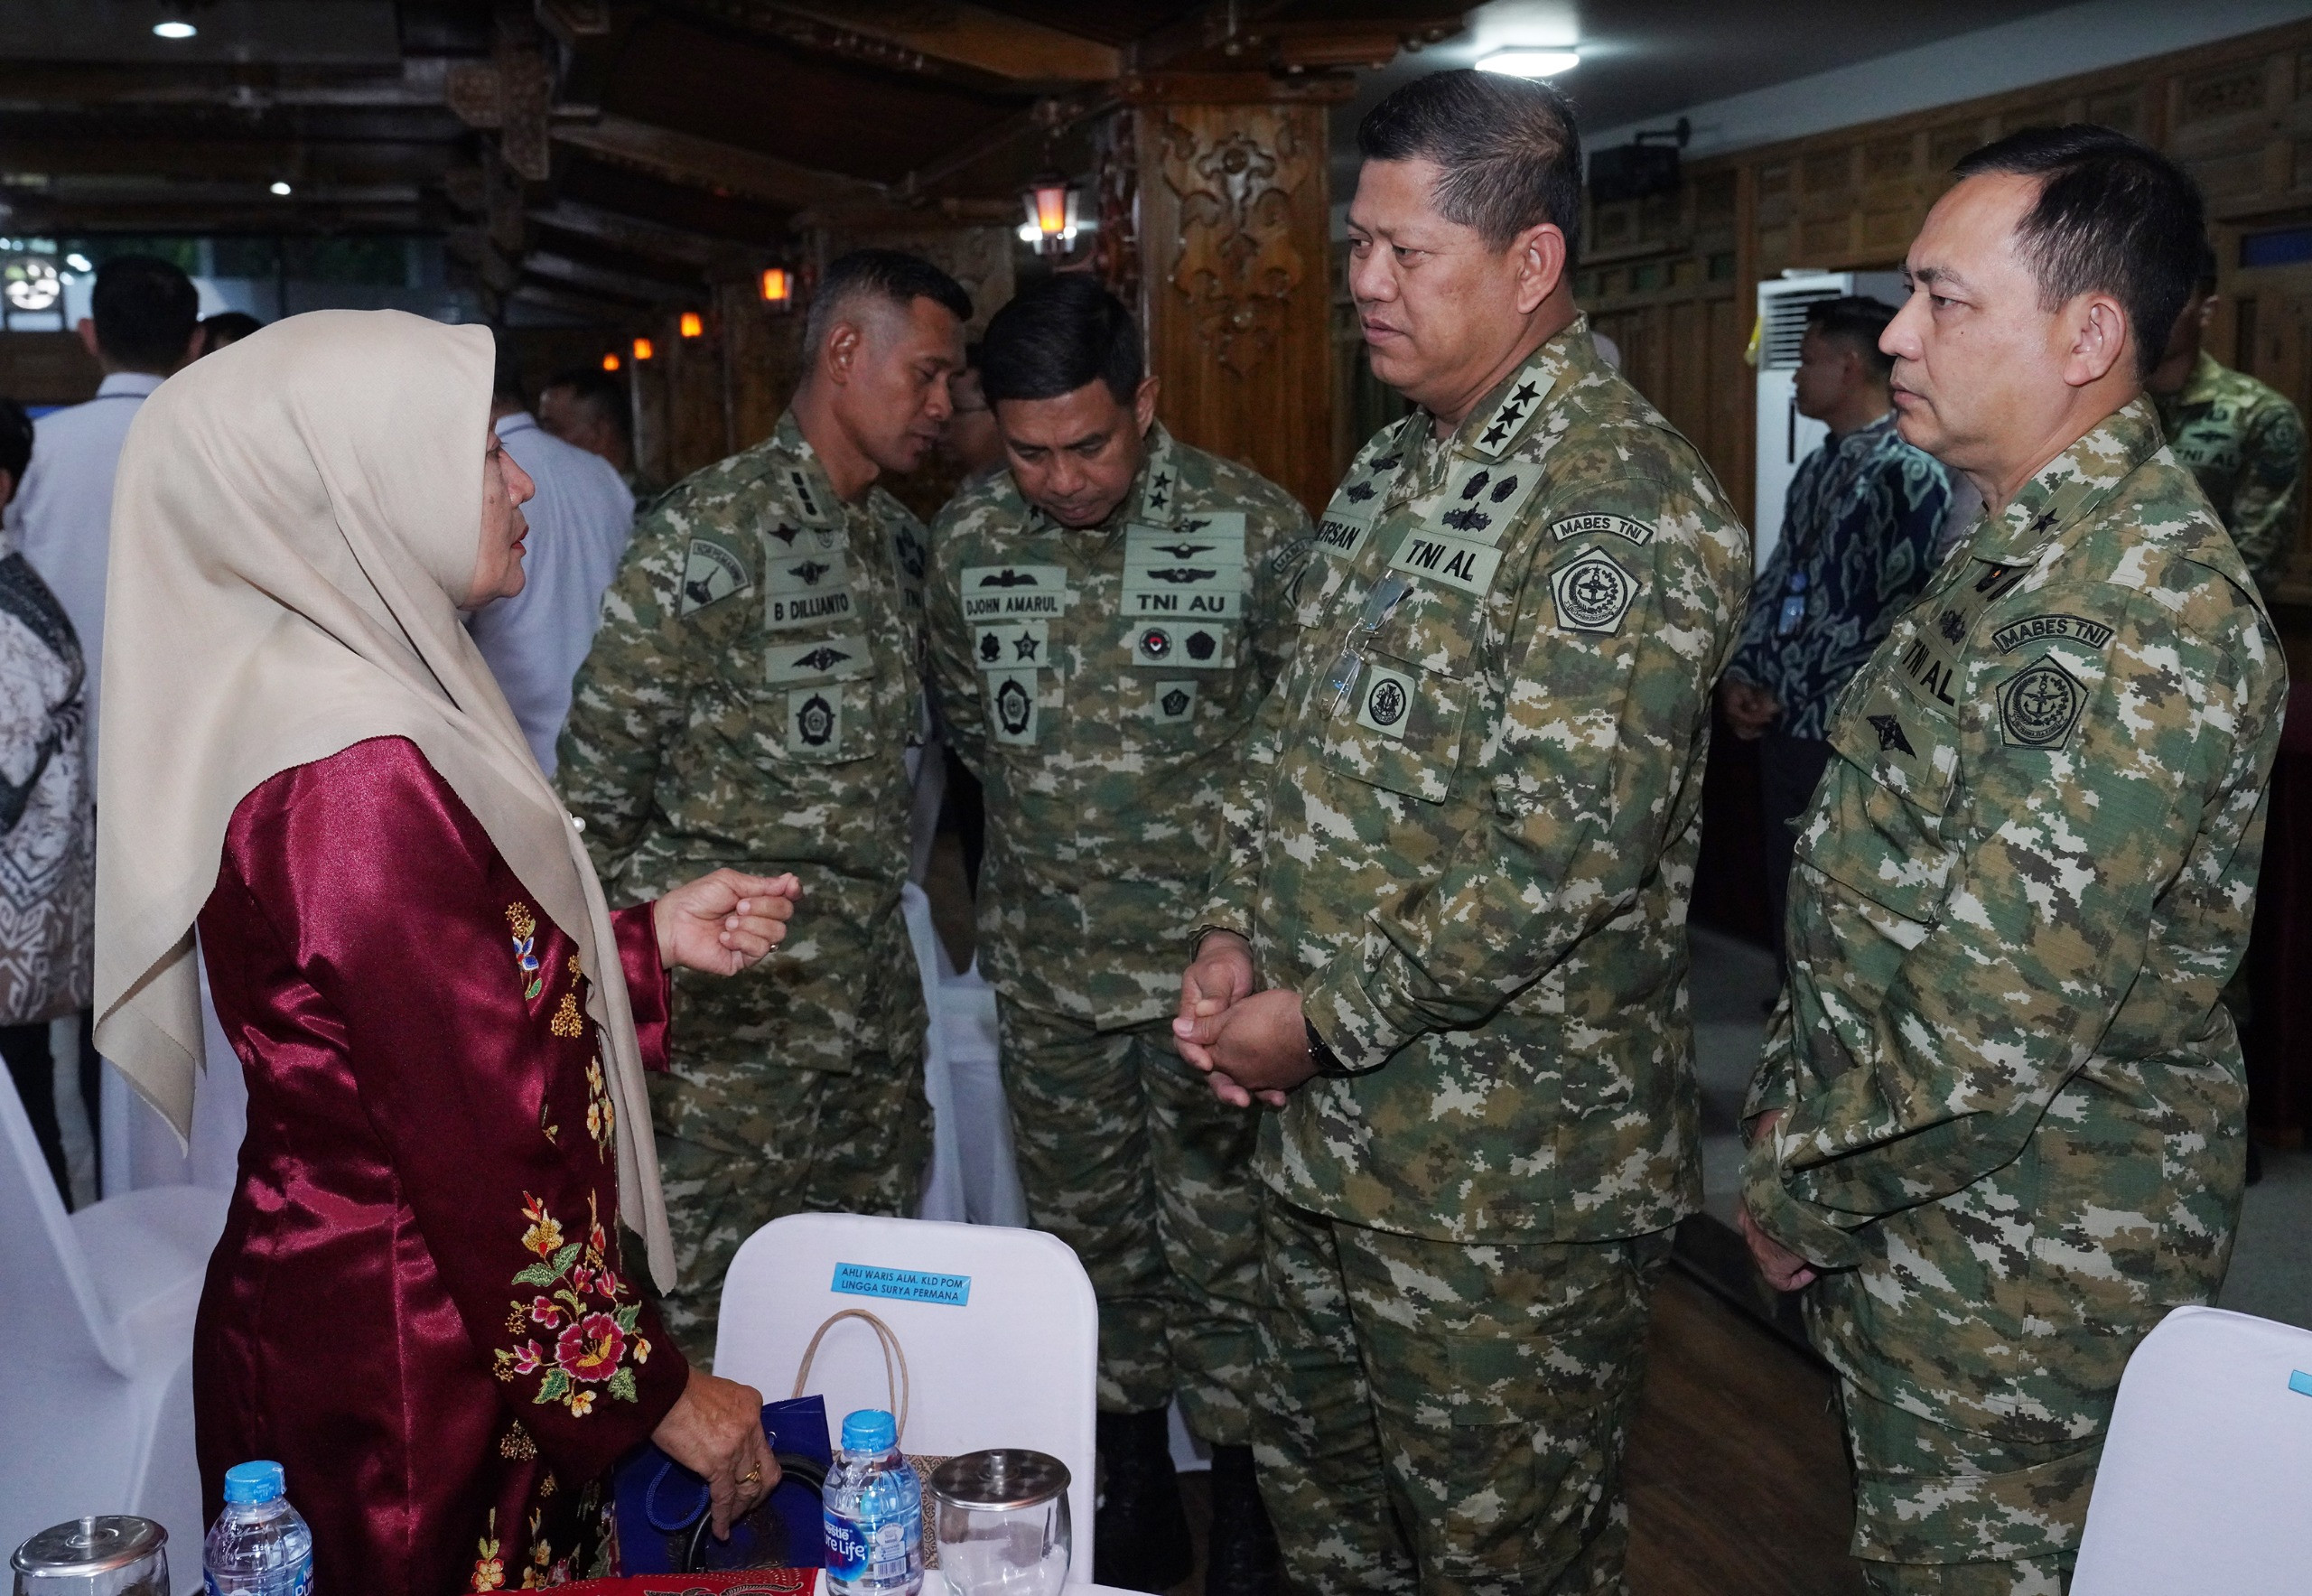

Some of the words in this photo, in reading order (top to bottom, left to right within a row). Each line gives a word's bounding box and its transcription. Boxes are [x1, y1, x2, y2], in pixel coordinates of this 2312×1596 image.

[1560, 518, 1611, 537] MABES
[1619, 520, 1642, 540] TNI
[1405, 539, 1447, 570] TNI
[1442, 550, 1477, 582] AL
[774, 602, 784, 621] B
[965, 598, 1000, 615] DJOHN
[1005, 596, 1058, 612] AMARUL
[1137, 594, 1178, 610] TNI
[1189, 596, 1225, 613] AU
[2000, 619, 2068, 648] MABES
[2074, 621, 2106, 644] TNI
[1902, 638, 1930, 678] TNI
[1919, 659, 1955, 707] AL
[842, 1267, 862, 1277] AHLI
[864, 1271, 893, 1281] WARIS
[896, 1274, 918, 1283] ALM.
[921, 1276, 938, 1286] KLD
[940, 1278, 963, 1289] POM
[841, 1280, 878, 1292] LINGGA
[881, 1284, 910, 1296] SURYA
[913, 1288, 958, 1301] PERMANA
[839, 1540, 865, 1563] Life
